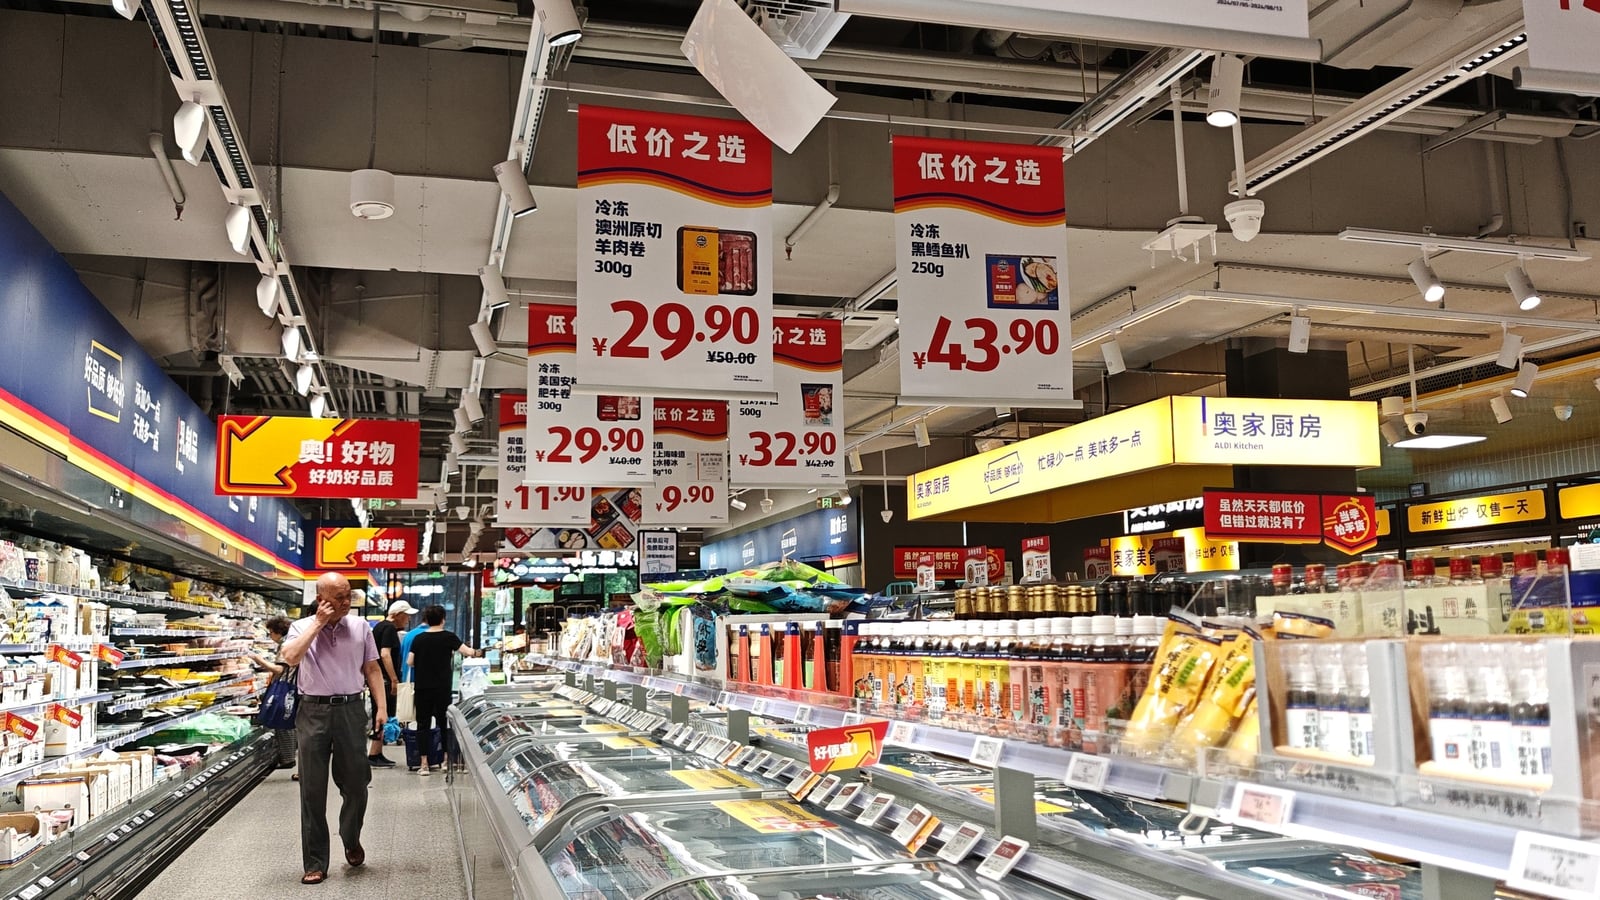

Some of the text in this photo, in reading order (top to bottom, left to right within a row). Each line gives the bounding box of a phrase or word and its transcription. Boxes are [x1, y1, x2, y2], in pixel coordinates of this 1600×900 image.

[607, 123, 746, 164] 低价之选
[917, 152, 1041, 186] 低价之选
[595, 199, 629, 217] 冷冻
[595, 219, 662, 239] 澳洲原切
[910, 223, 940, 239] 冷冻
[595, 239, 646, 258] 羊肉卷
[911, 242, 970, 259] 黑鳕鱼扒
[594, 260, 632, 277] 300g
[911, 261, 944, 277] 250g
[538, 363, 560, 374] 冷冻
[538, 388, 570, 400] 肥牛卷
[537, 401, 562, 412] 300g
[739, 407, 762, 418] 500g
[1213, 411, 1322, 438] 奥家厨房
[1037, 430, 1142, 472] 忙碌少一点 美味多一点
[1234, 442, 1264, 450] Kitchen
[309, 469, 394, 486] 好奶好品质
[1219, 498, 1306, 515] 虽然天天都低价
[1476, 498, 1530, 519] 仅售一天
[1219, 514, 1306, 530] 但错过就没有了
